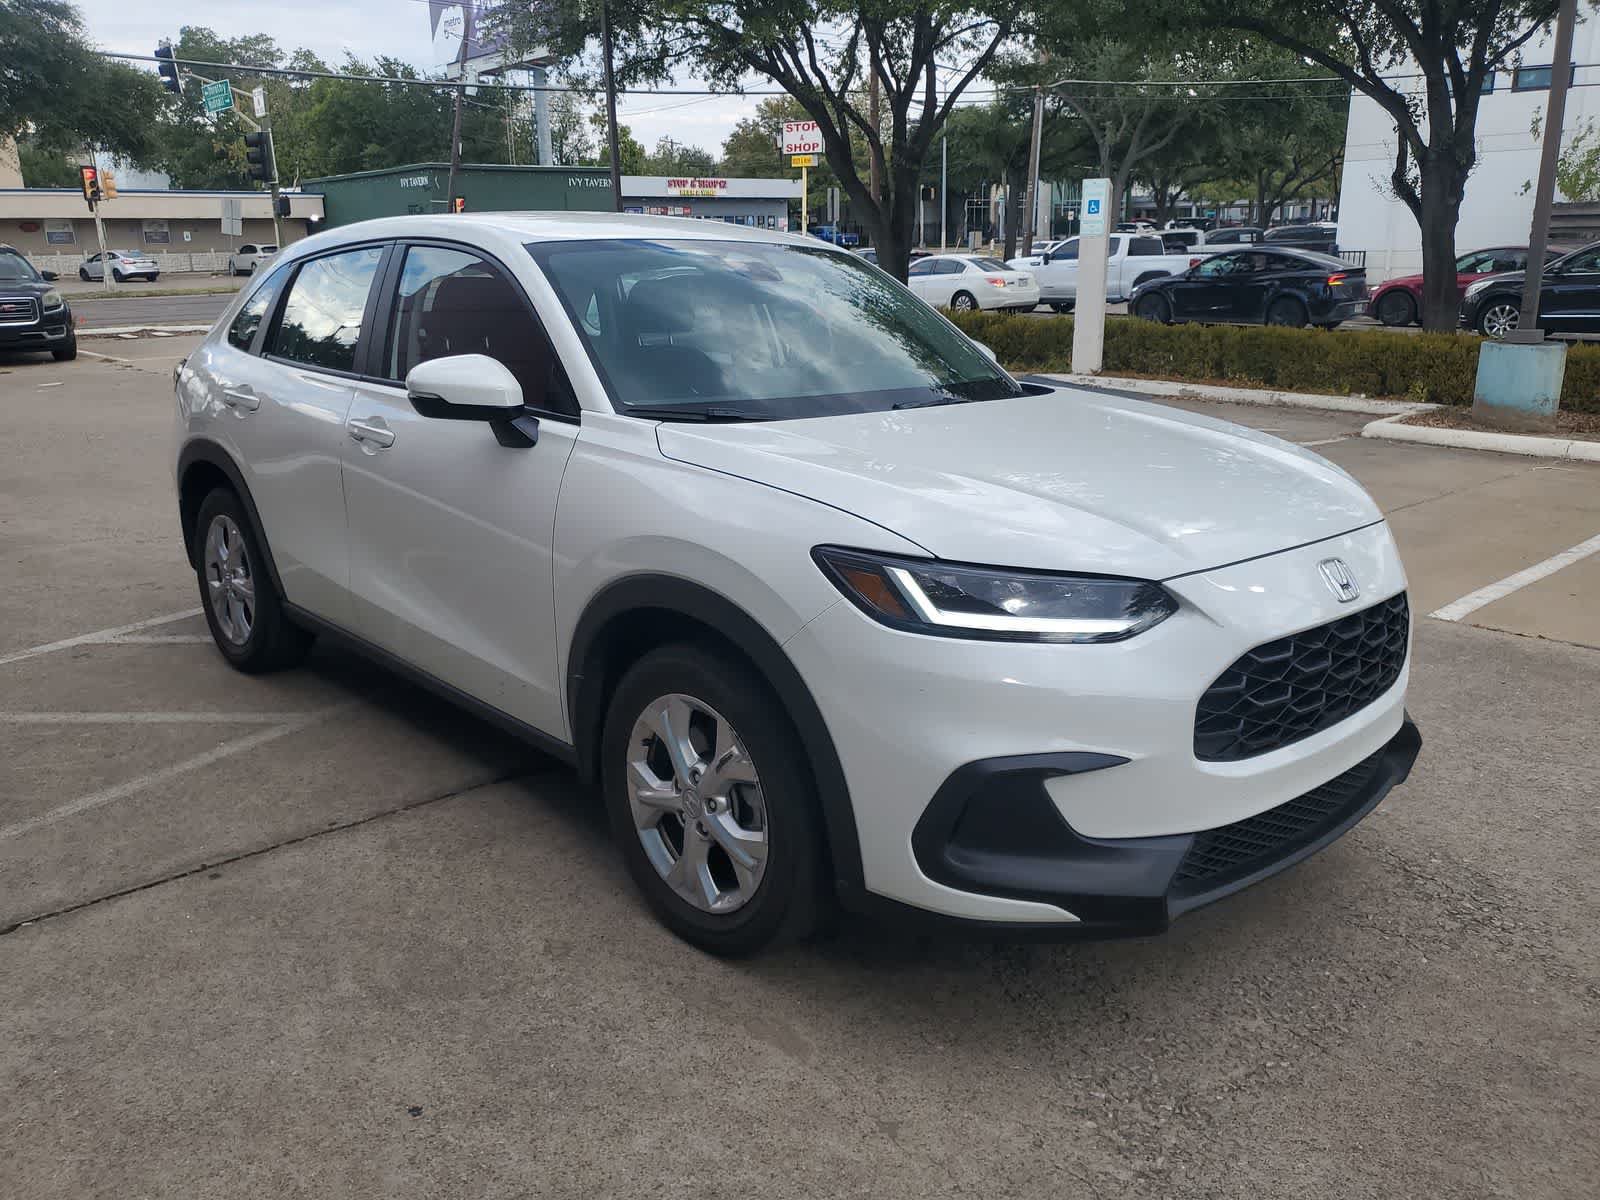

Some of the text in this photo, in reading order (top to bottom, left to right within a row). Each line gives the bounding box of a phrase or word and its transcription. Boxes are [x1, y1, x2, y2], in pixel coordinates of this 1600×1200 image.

[444, 16, 462, 27] metro
[786, 122, 818, 133] STOP
[786, 142, 819, 153] SHOP
[400, 176, 429, 188] IVY TAVERN
[568, 177, 614, 188] IVY TAVERN
[668, 179, 689, 188] STOP
